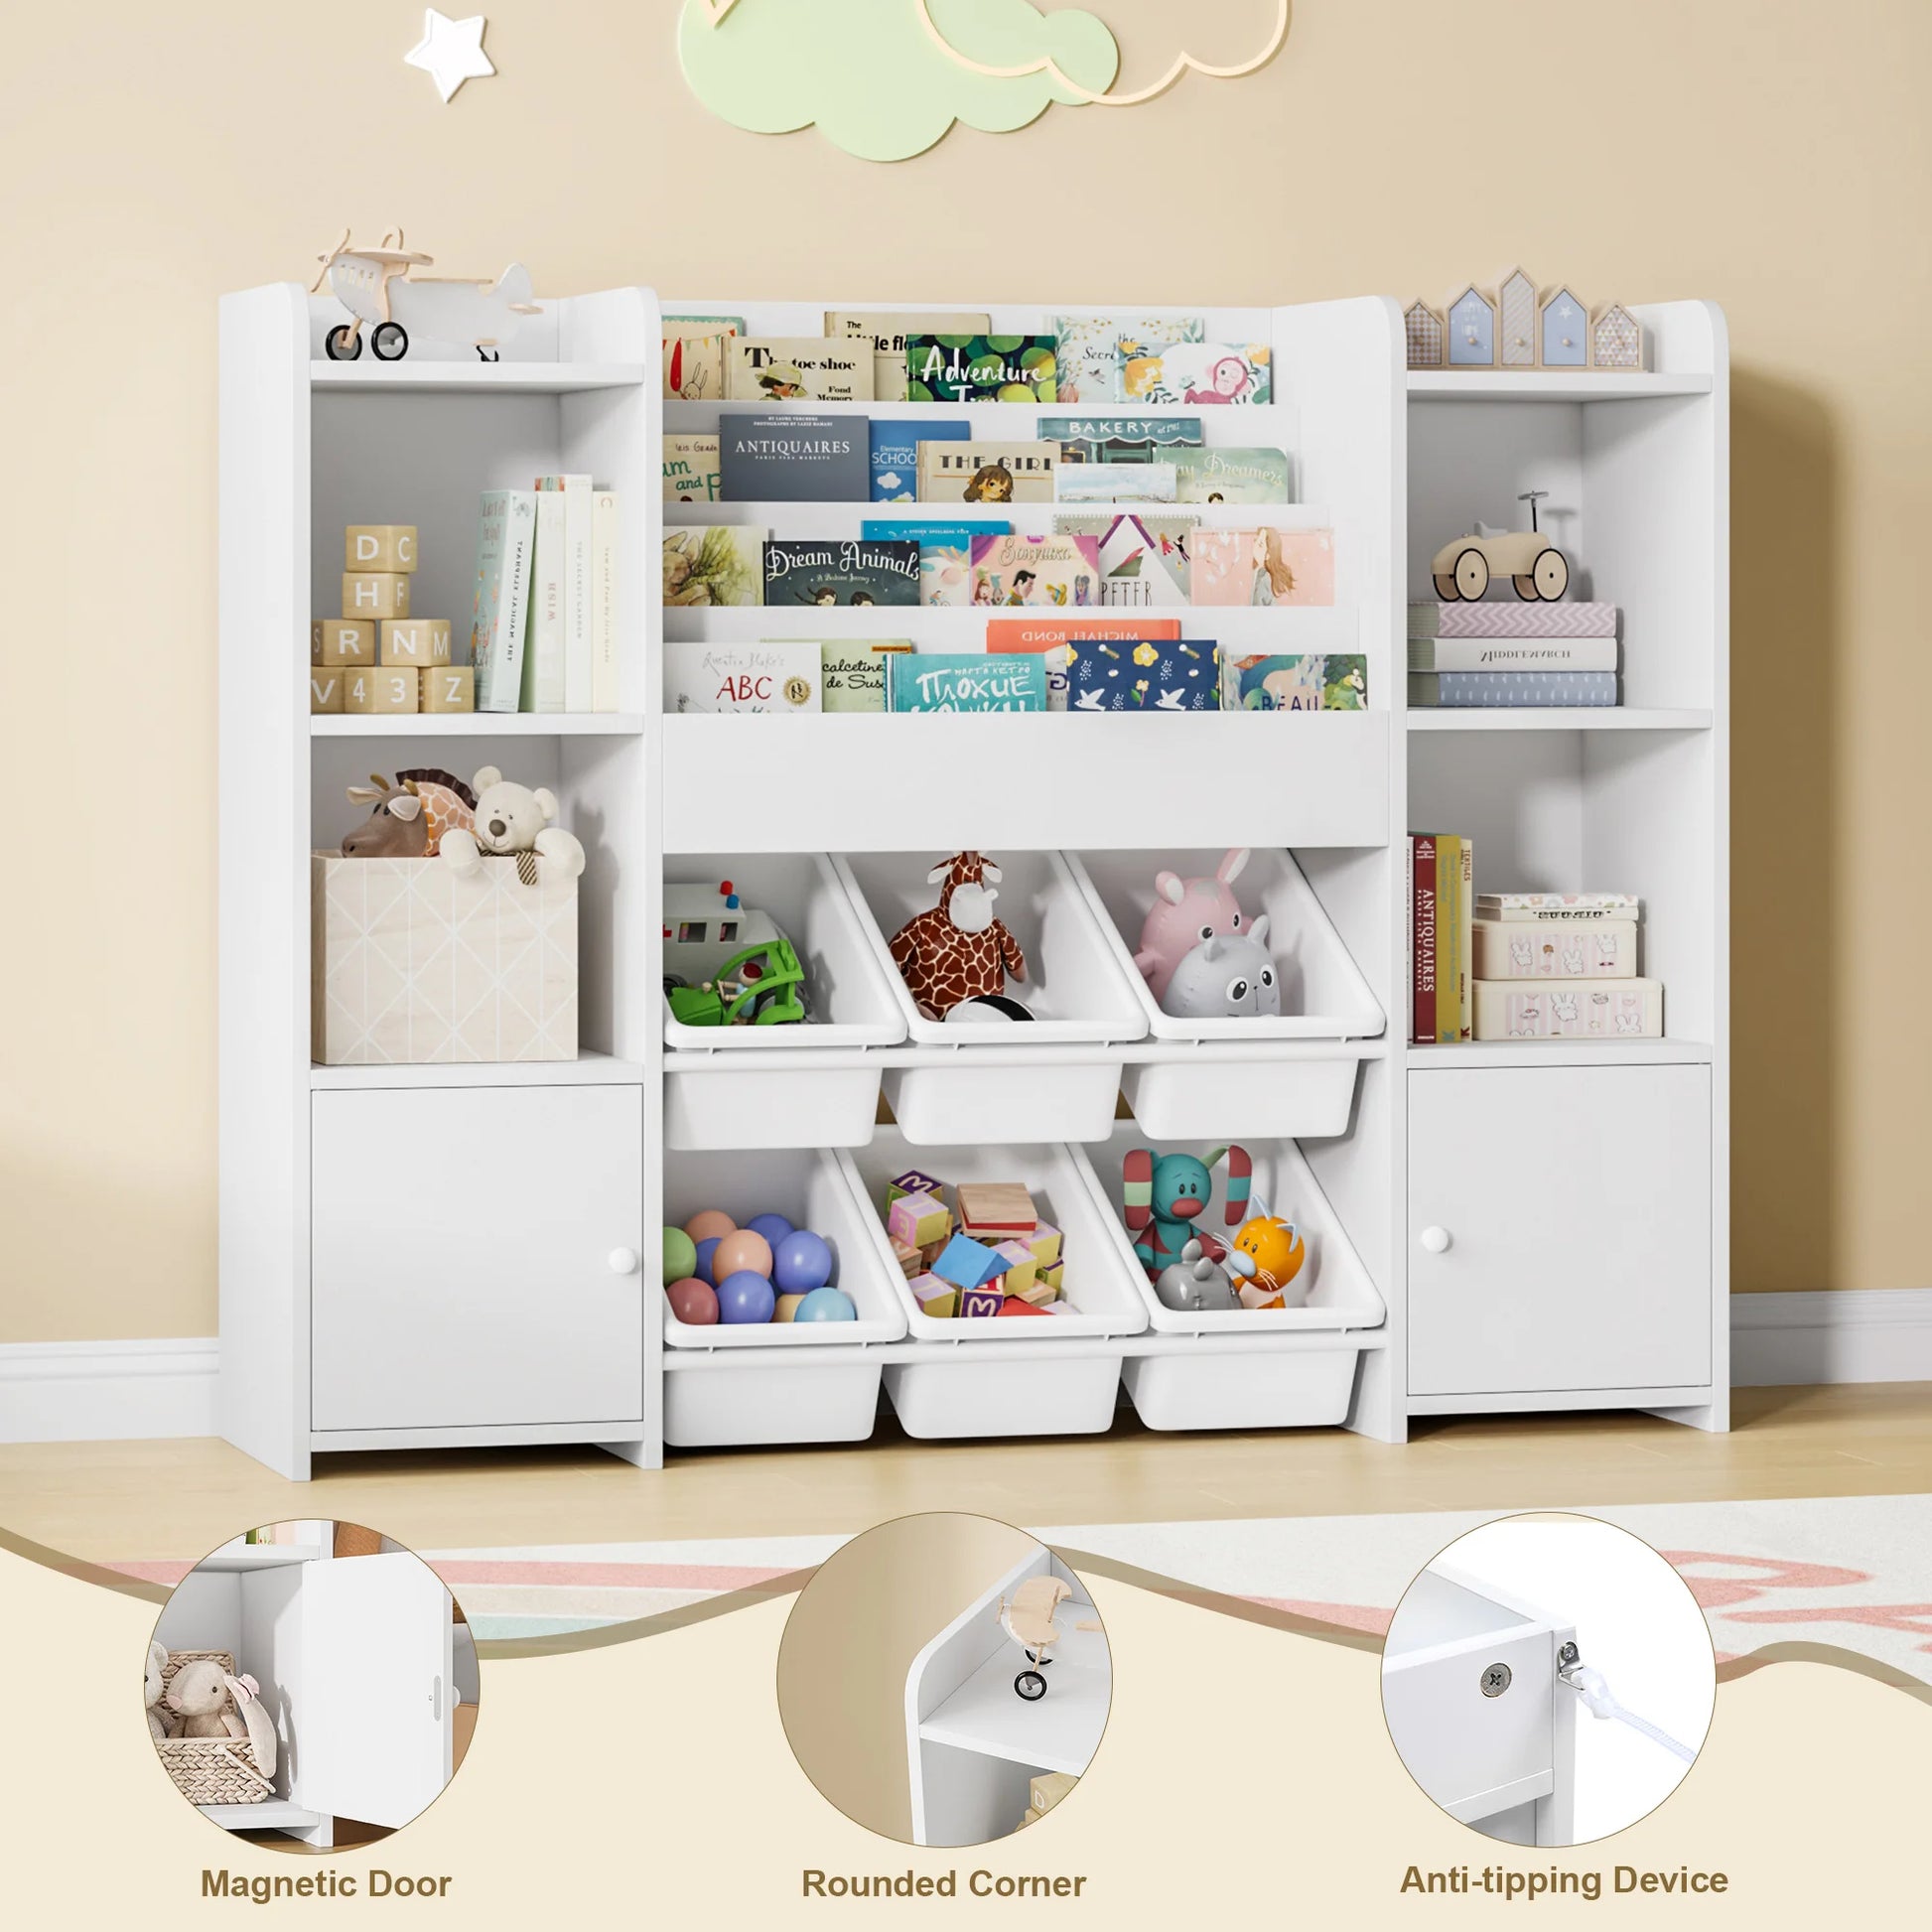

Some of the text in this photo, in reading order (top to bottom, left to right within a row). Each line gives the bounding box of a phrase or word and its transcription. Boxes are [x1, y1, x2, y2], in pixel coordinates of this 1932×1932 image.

[819, 357, 857, 370] shoe
[920, 345, 1046, 383] Adventure
[828, 385, 852, 394] Fond
[1068, 422, 1153, 434] BAKERY
[735, 440, 851, 456] ANTIQUAIRES
[938, 456, 1053, 471] THE GIRL
[1201, 452, 1284, 487] Dreamers
[676, 477, 704, 490] and
[356, 535, 379, 561] D
[398, 536, 411, 562] C
[764, 541, 920, 582] Dream Animals
[355, 582, 378, 608] H
[396, 582, 404, 608] F
[1101, 581, 1153, 606] PETER
[339, 629, 361, 654] R
[392, 629, 417, 655] N
[433, 631, 448, 656] M
[311, 679, 336, 704] V
[352, 677, 365, 703] 4
[390, 677, 406, 703] 3
[445, 677, 462, 703] Z
[716, 675, 772, 702] ABC
[826, 674, 843, 689] de
[1423, 890, 1435, 992] ANTIQUAIRES
